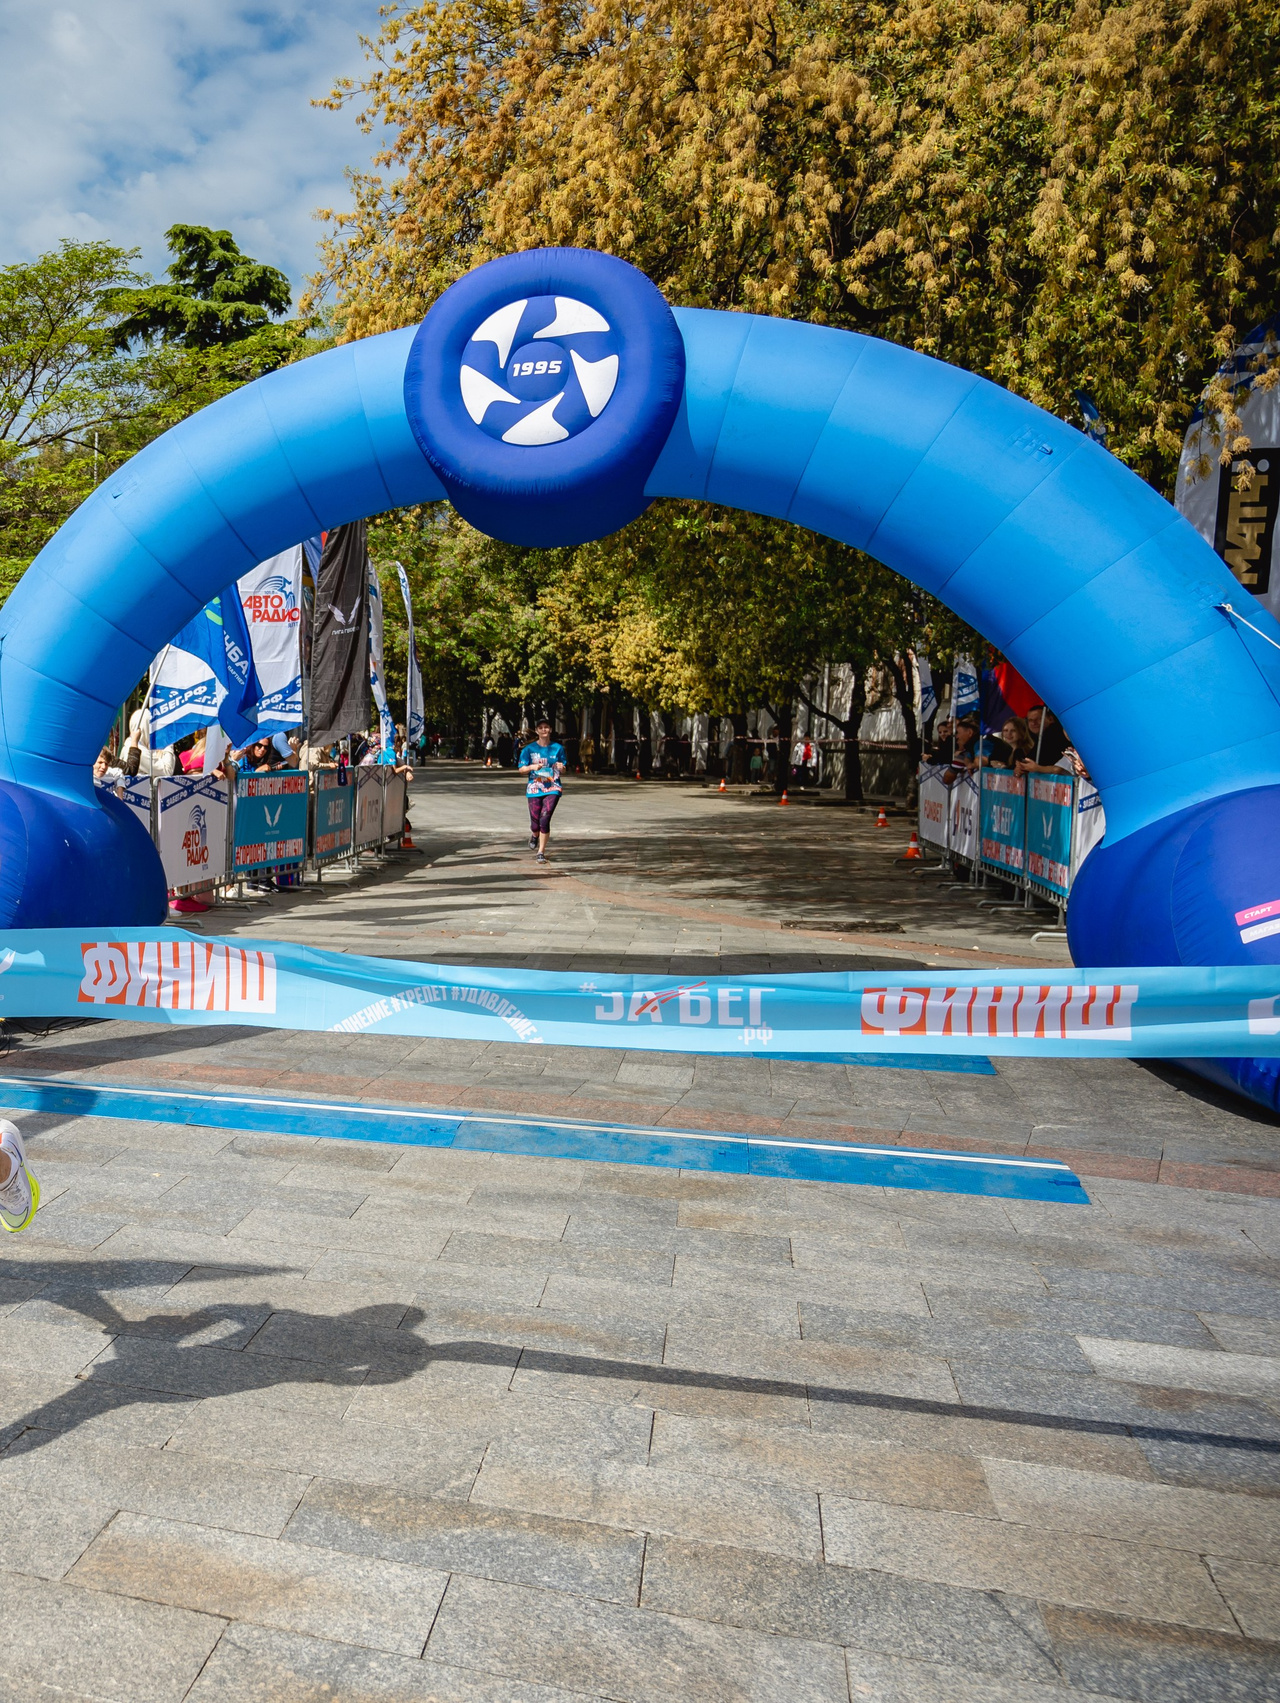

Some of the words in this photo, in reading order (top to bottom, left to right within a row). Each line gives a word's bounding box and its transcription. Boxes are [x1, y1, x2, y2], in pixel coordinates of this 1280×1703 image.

[512, 360, 562, 377] 1995
[242, 594, 283, 609] АВТО
[252, 608, 300, 623] РАДИО
[182, 830, 200, 849] АВТО
[187, 846, 209, 867] РАДИО
[1244, 906, 1272, 919] СТАРТ
[79, 942, 277, 1014] ФИНИШ
[390, 985, 448, 1013] #ТРЕПЕТ
[451, 986, 538, 1040] #УДИВЛЕНИЕ
[860, 985, 1139, 1041] ФИНИШ
